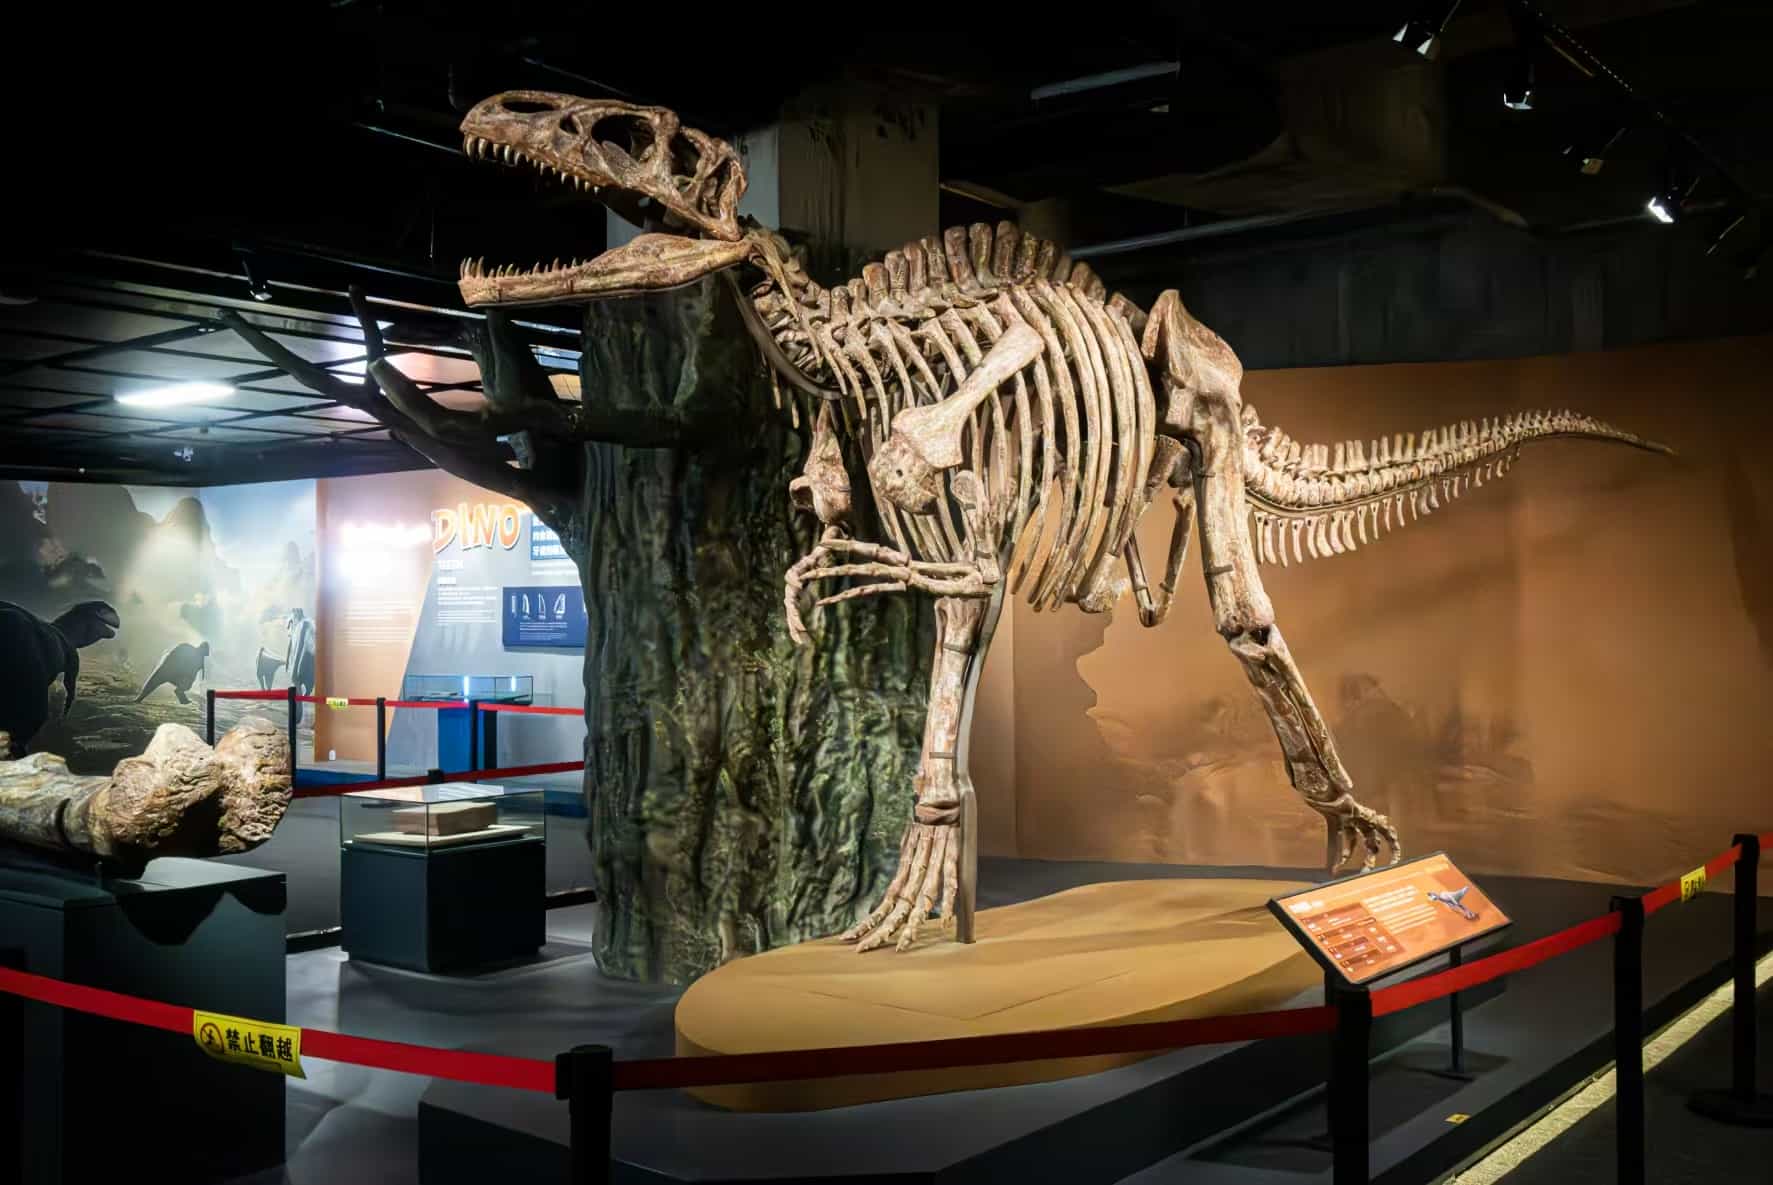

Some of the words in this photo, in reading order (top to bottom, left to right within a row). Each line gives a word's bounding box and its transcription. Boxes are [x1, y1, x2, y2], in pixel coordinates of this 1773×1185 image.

[431, 502, 521, 553] DINO
[225, 1028, 293, 1061] 禁止翻越
